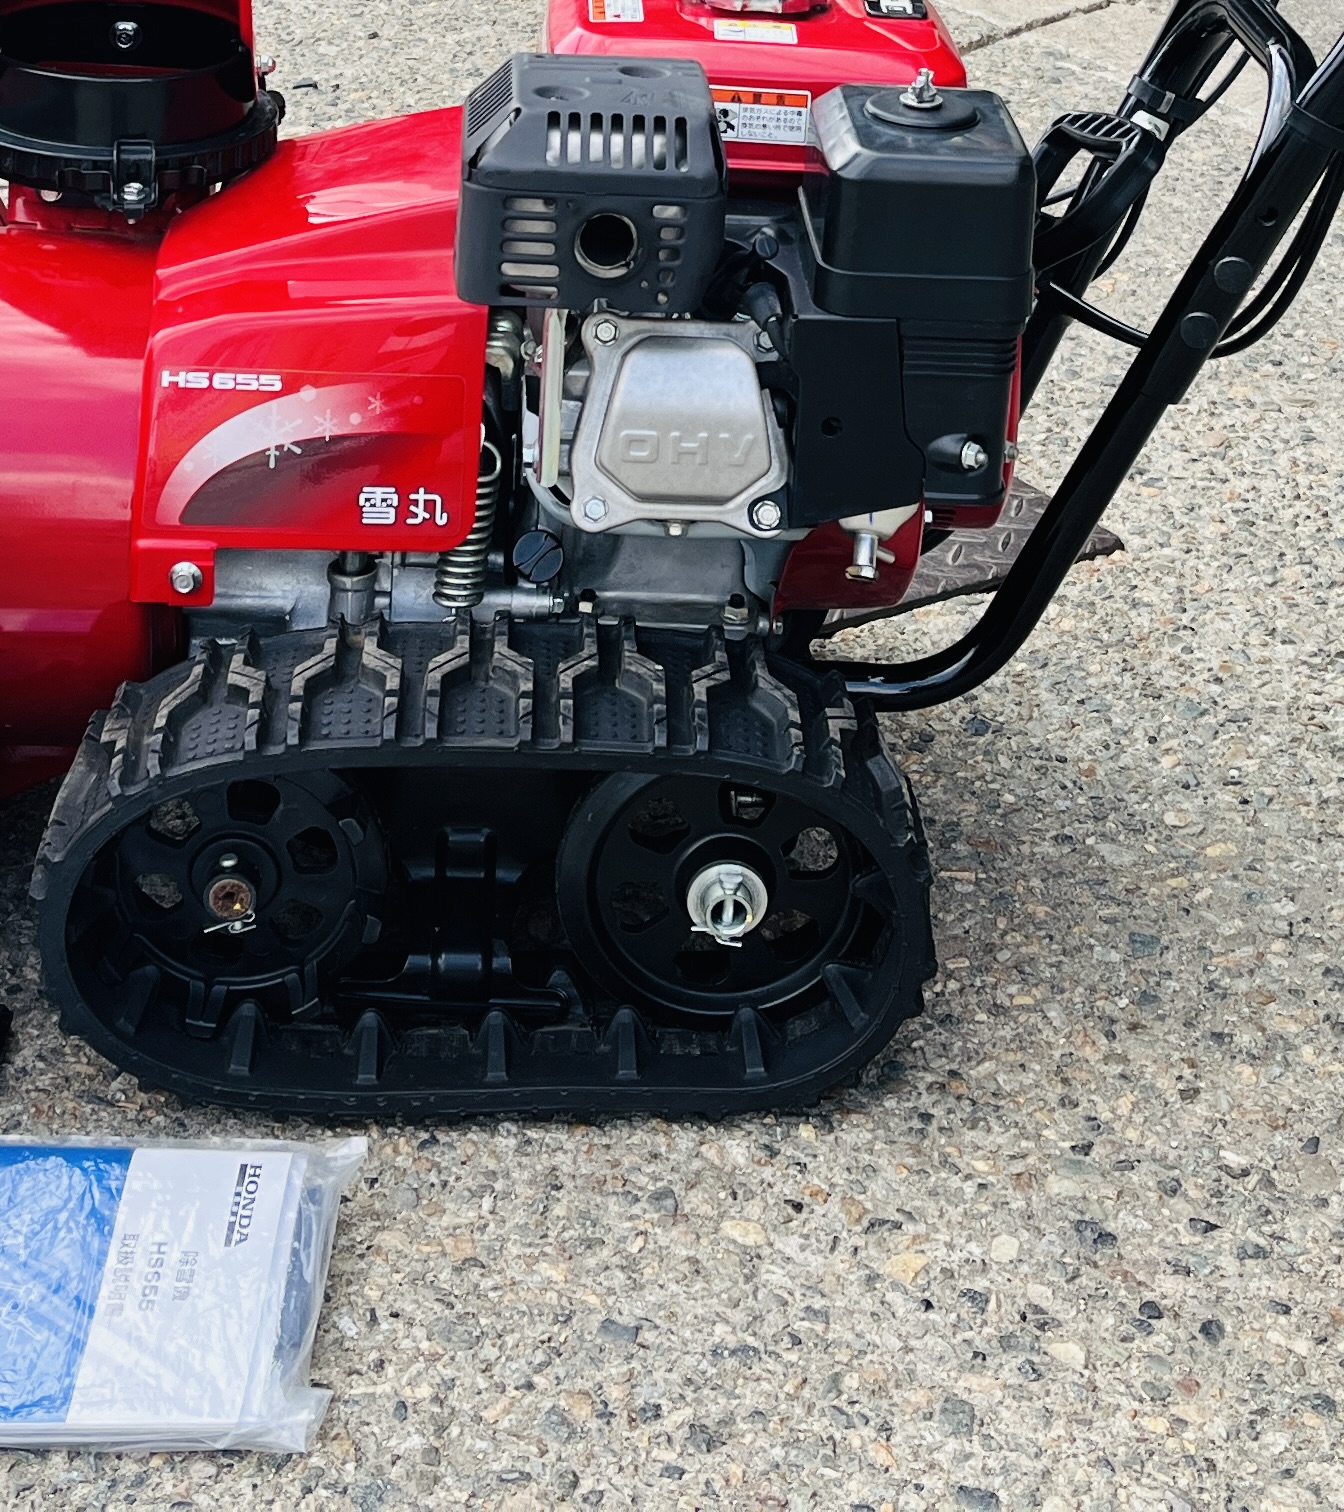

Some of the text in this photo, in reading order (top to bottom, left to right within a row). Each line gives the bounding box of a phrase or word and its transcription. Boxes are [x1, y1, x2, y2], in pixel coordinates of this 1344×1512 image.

[161, 369, 284, 393] HS655
[619, 429, 754, 466] OHV
[358, 486, 449, 527] 雪丸
[234, 1163, 263, 1247] HONDA
